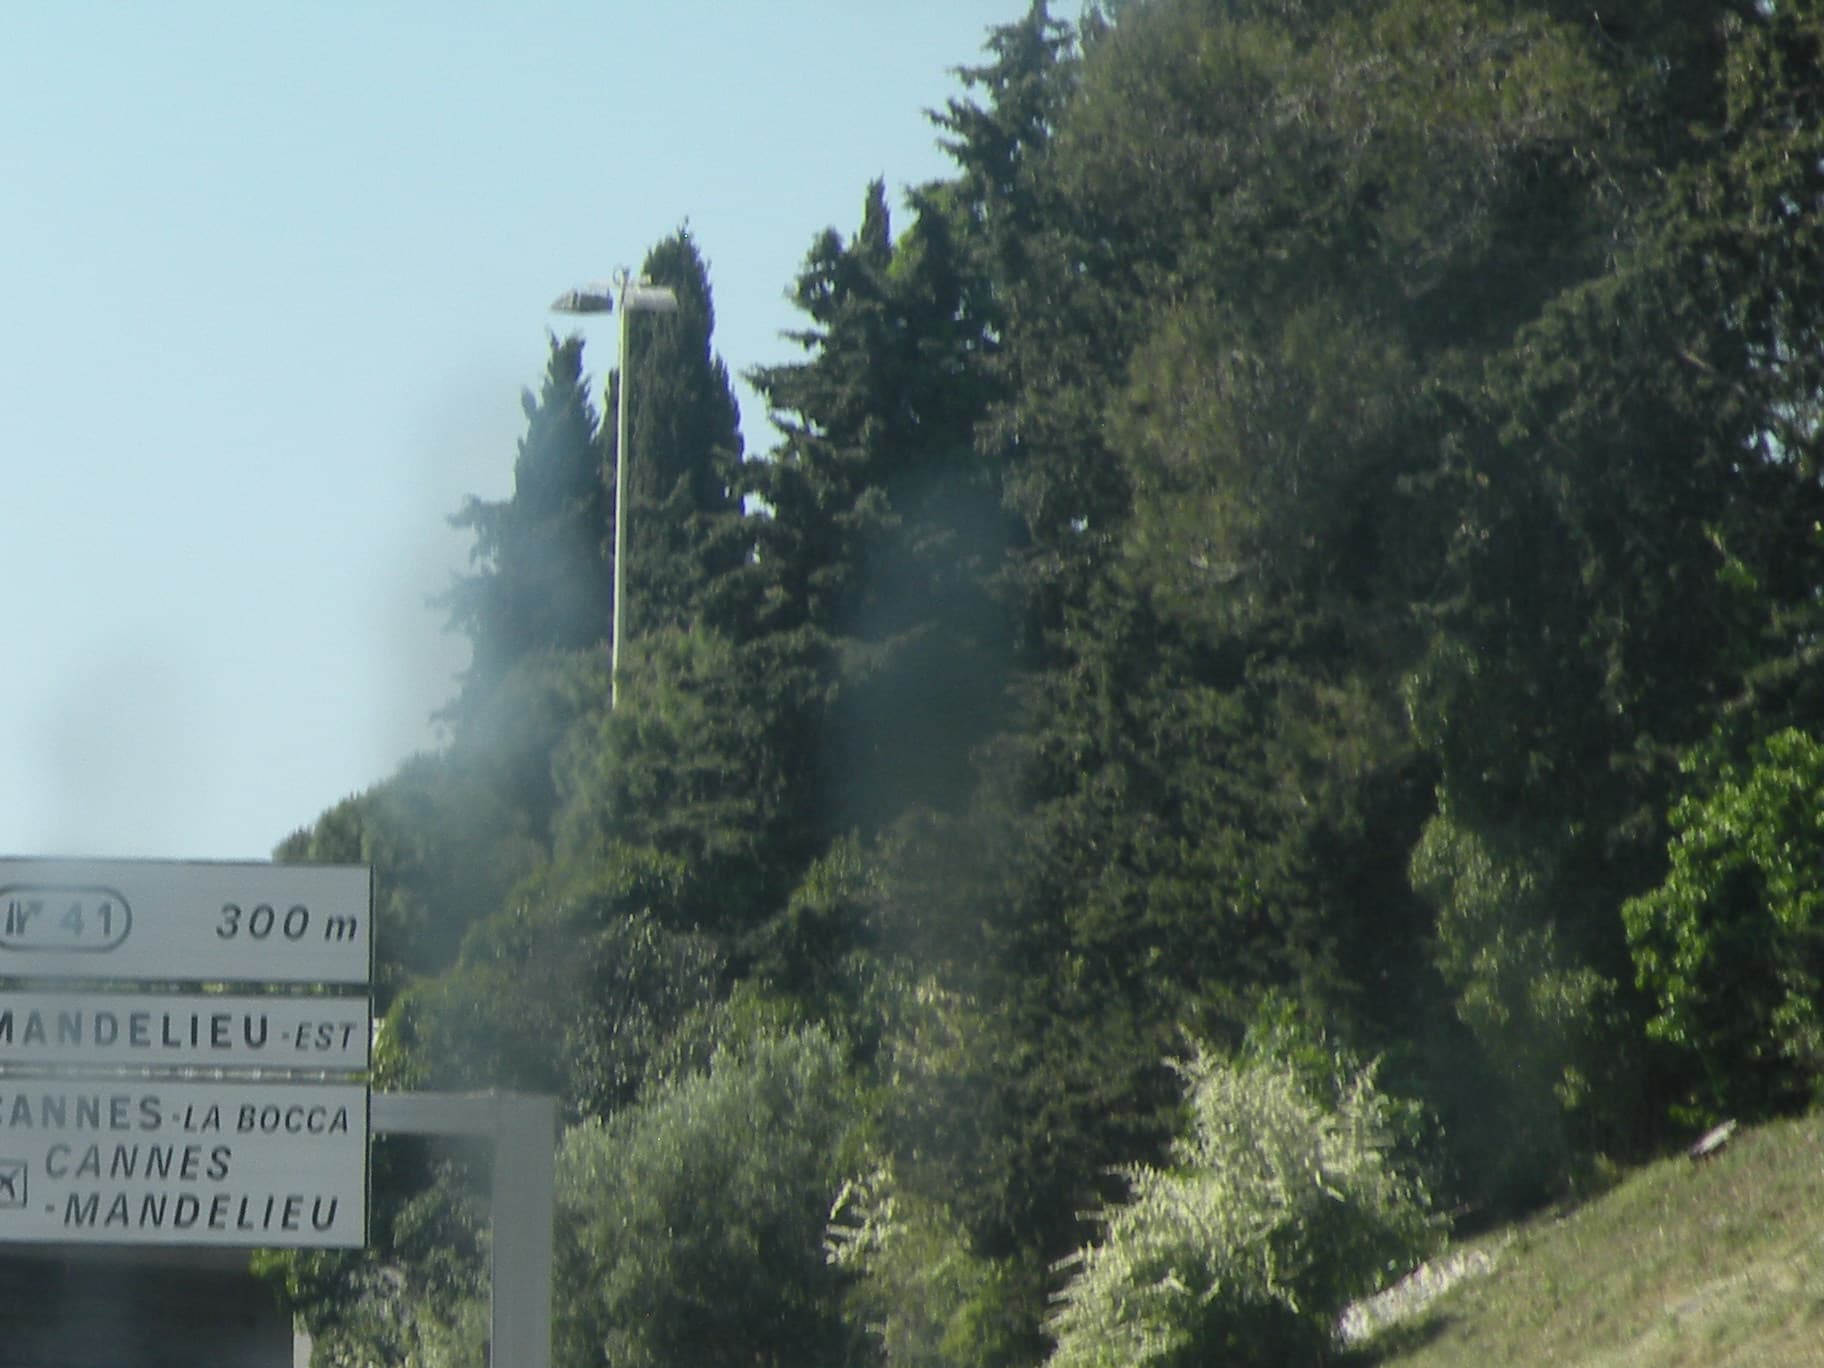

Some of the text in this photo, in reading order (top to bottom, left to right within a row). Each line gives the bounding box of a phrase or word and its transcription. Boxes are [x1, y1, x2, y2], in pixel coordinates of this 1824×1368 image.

[215, 903, 311, 941] 300
[323, 913, 358, 943] m
[236, 1103, 349, 1134] BOCCA
[45, 1143, 233, 1182] CANNES
